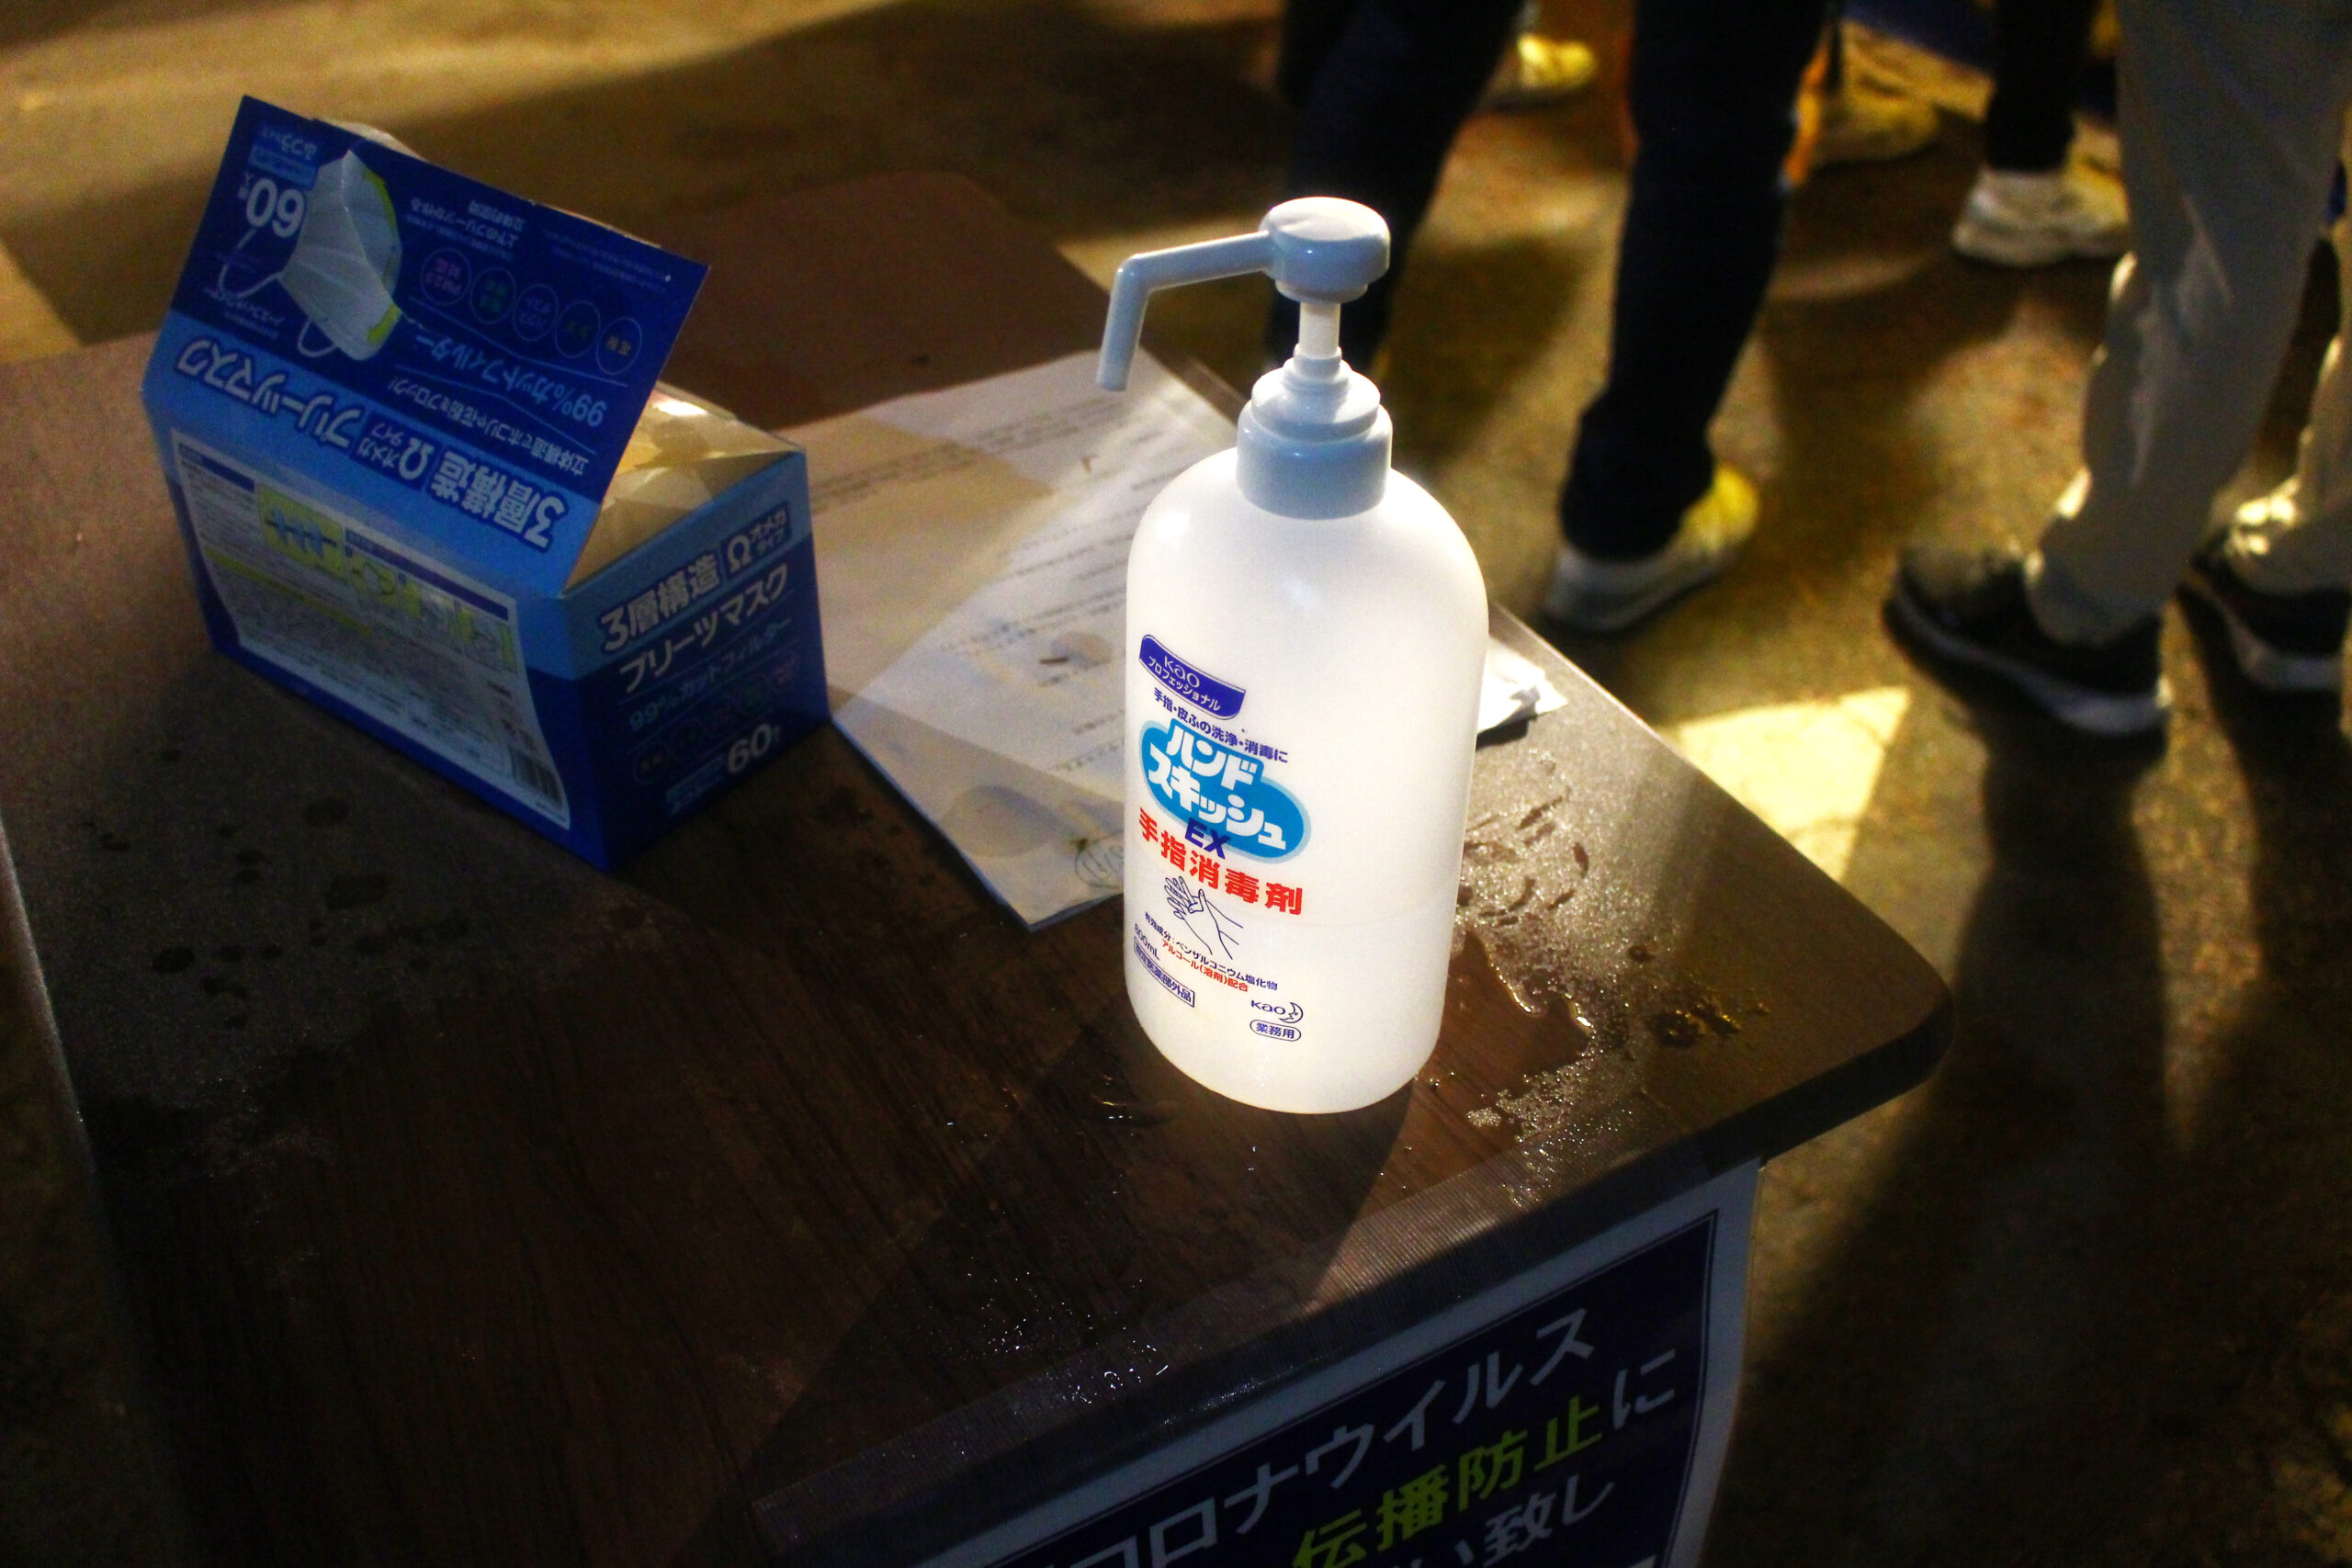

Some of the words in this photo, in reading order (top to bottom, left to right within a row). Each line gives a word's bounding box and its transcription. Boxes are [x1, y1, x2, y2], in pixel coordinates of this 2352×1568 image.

[245, 176, 305, 239] 60
[177, 340, 361, 448] プリーツマスク
[415, 333, 607, 428] 99%カットフィルター
[356, 438, 401, 471] オメガ
[432, 450, 565, 547] 3層構造
[600, 553, 720, 651] 3層構造
[619, 563, 787, 694] プリーツマスク
[1148, 655, 1221, 712] プロフェッショナル
[1163, 655, 1201, 689] kao
[728, 723, 772, 774] 60
[1153, 687, 1289, 763] 手指・皮ふの洗浄・消毒に
[1165, 723, 1258, 791] ハンド
[1148, 741, 1287, 851] スキッシュ
[1139, 806, 1303, 916] 手指消毒剤
[1184, 817, 1232, 860] EX
[1250, 999, 1286, 1017] kao
[1255, 1021, 1295, 1040] 業務用
[1069, 1308, 1596, 1568] コロナウイルス
[1291, 1348, 1677, 1568] 伝播防止に
